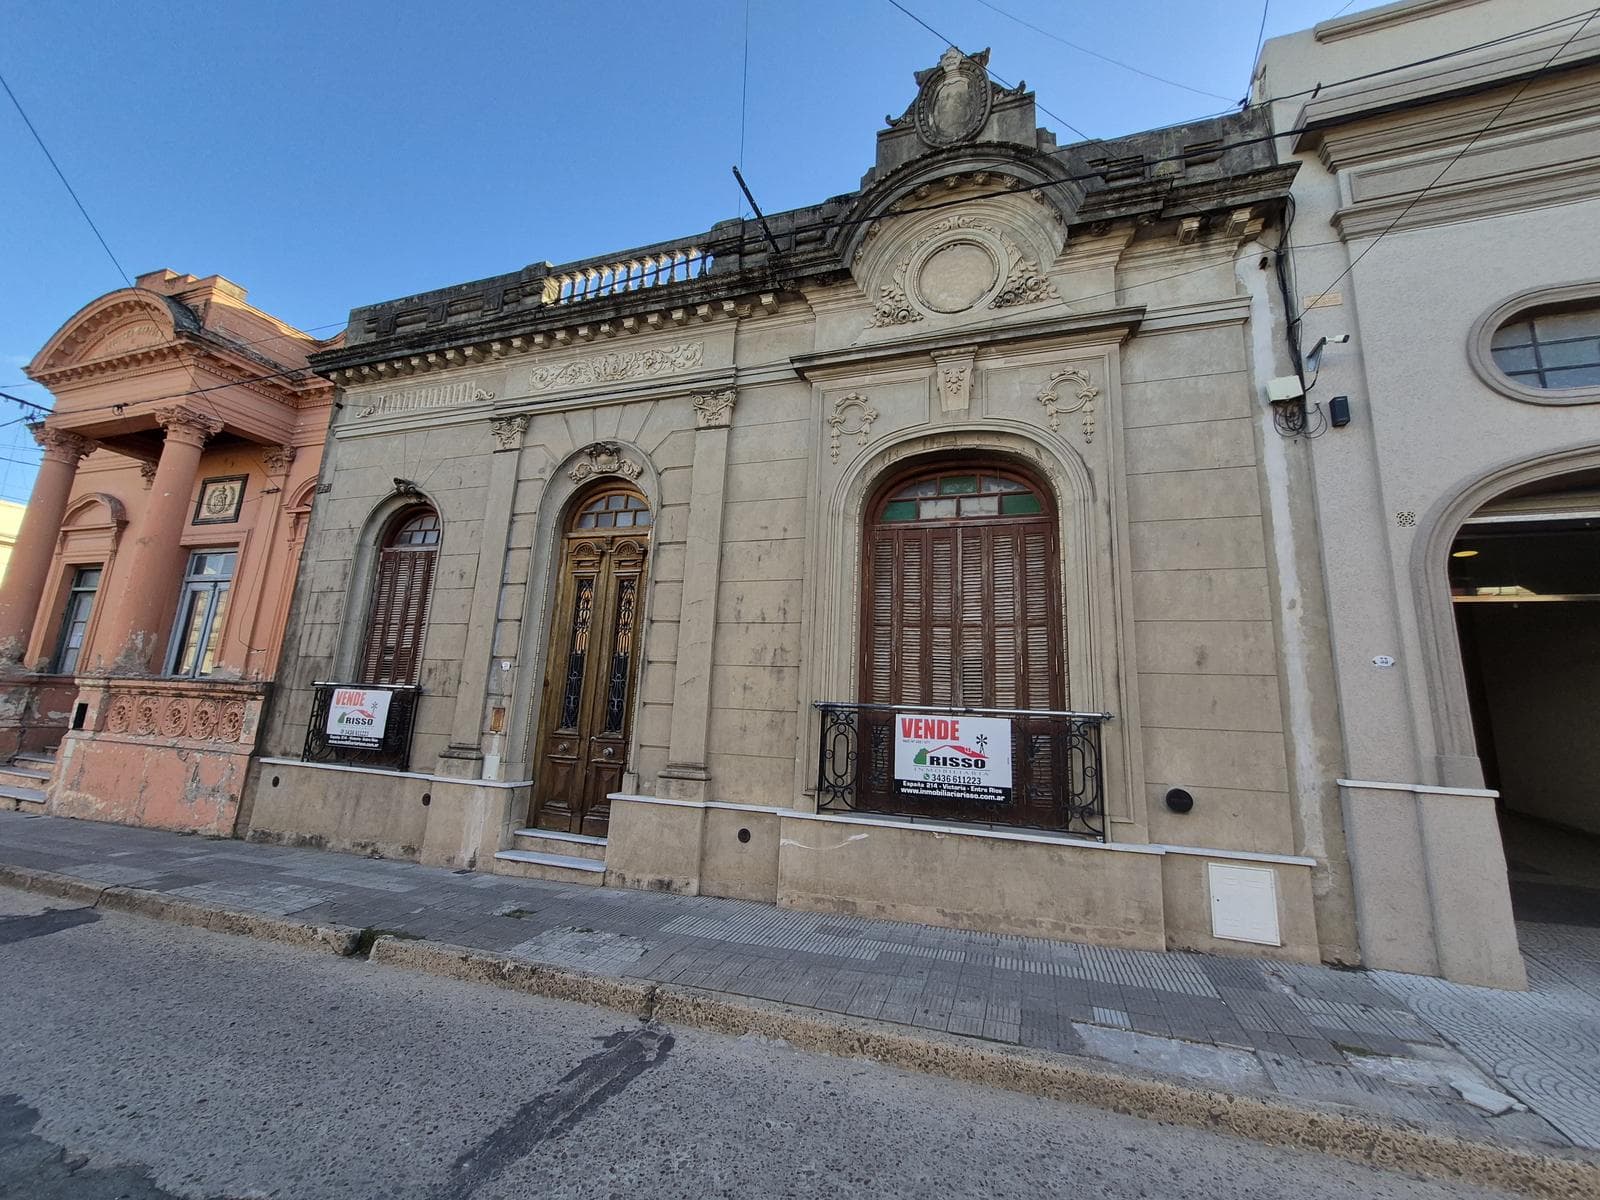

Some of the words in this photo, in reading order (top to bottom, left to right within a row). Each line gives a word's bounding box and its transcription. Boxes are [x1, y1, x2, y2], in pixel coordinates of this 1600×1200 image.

[336, 691, 366, 706] VENDE
[345, 717, 374, 726] RISSO
[901, 718, 959, 740] VENDE
[929, 756, 986, 769] RISSO
[942, 783, 966, 791] Victoria
[900, 787, 1006, 801] www.inmobiliariarisso.com.ar
